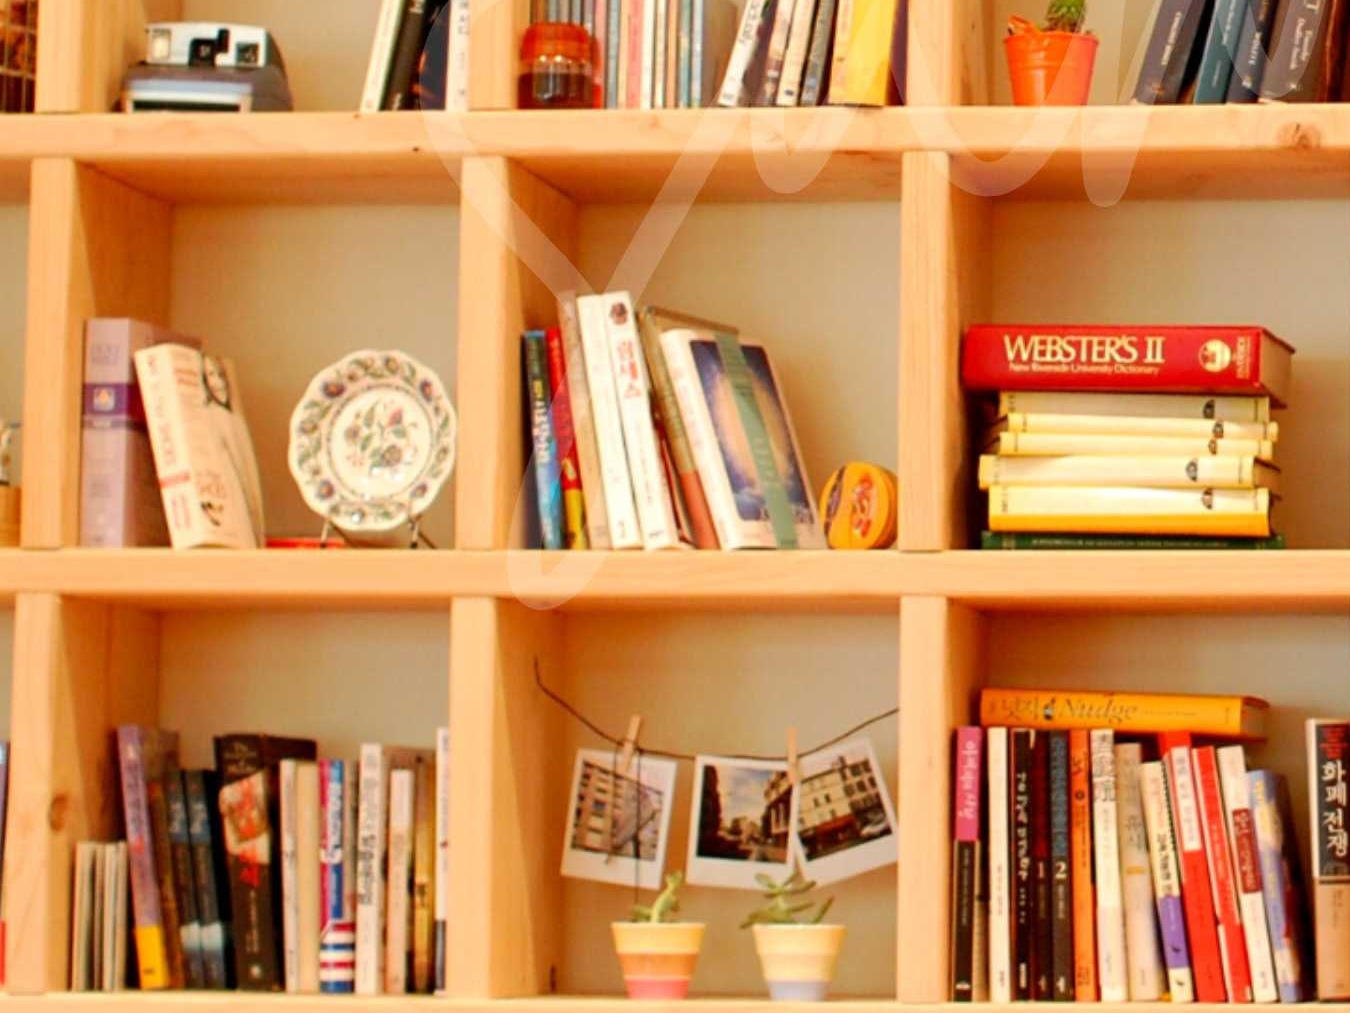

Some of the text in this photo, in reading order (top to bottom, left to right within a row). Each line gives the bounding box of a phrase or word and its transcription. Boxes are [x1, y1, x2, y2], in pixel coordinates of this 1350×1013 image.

[1003, 335, 1165, 363] WEBSTER'S II
[1008, 363, 1030, 371] New
[1071, 363, 1112, 374] University
[1114, 364, 1159, 374] Dictionary
[1059, 698, 1137, 723] Nudge
[1055, 860, 1065, 879] 2
